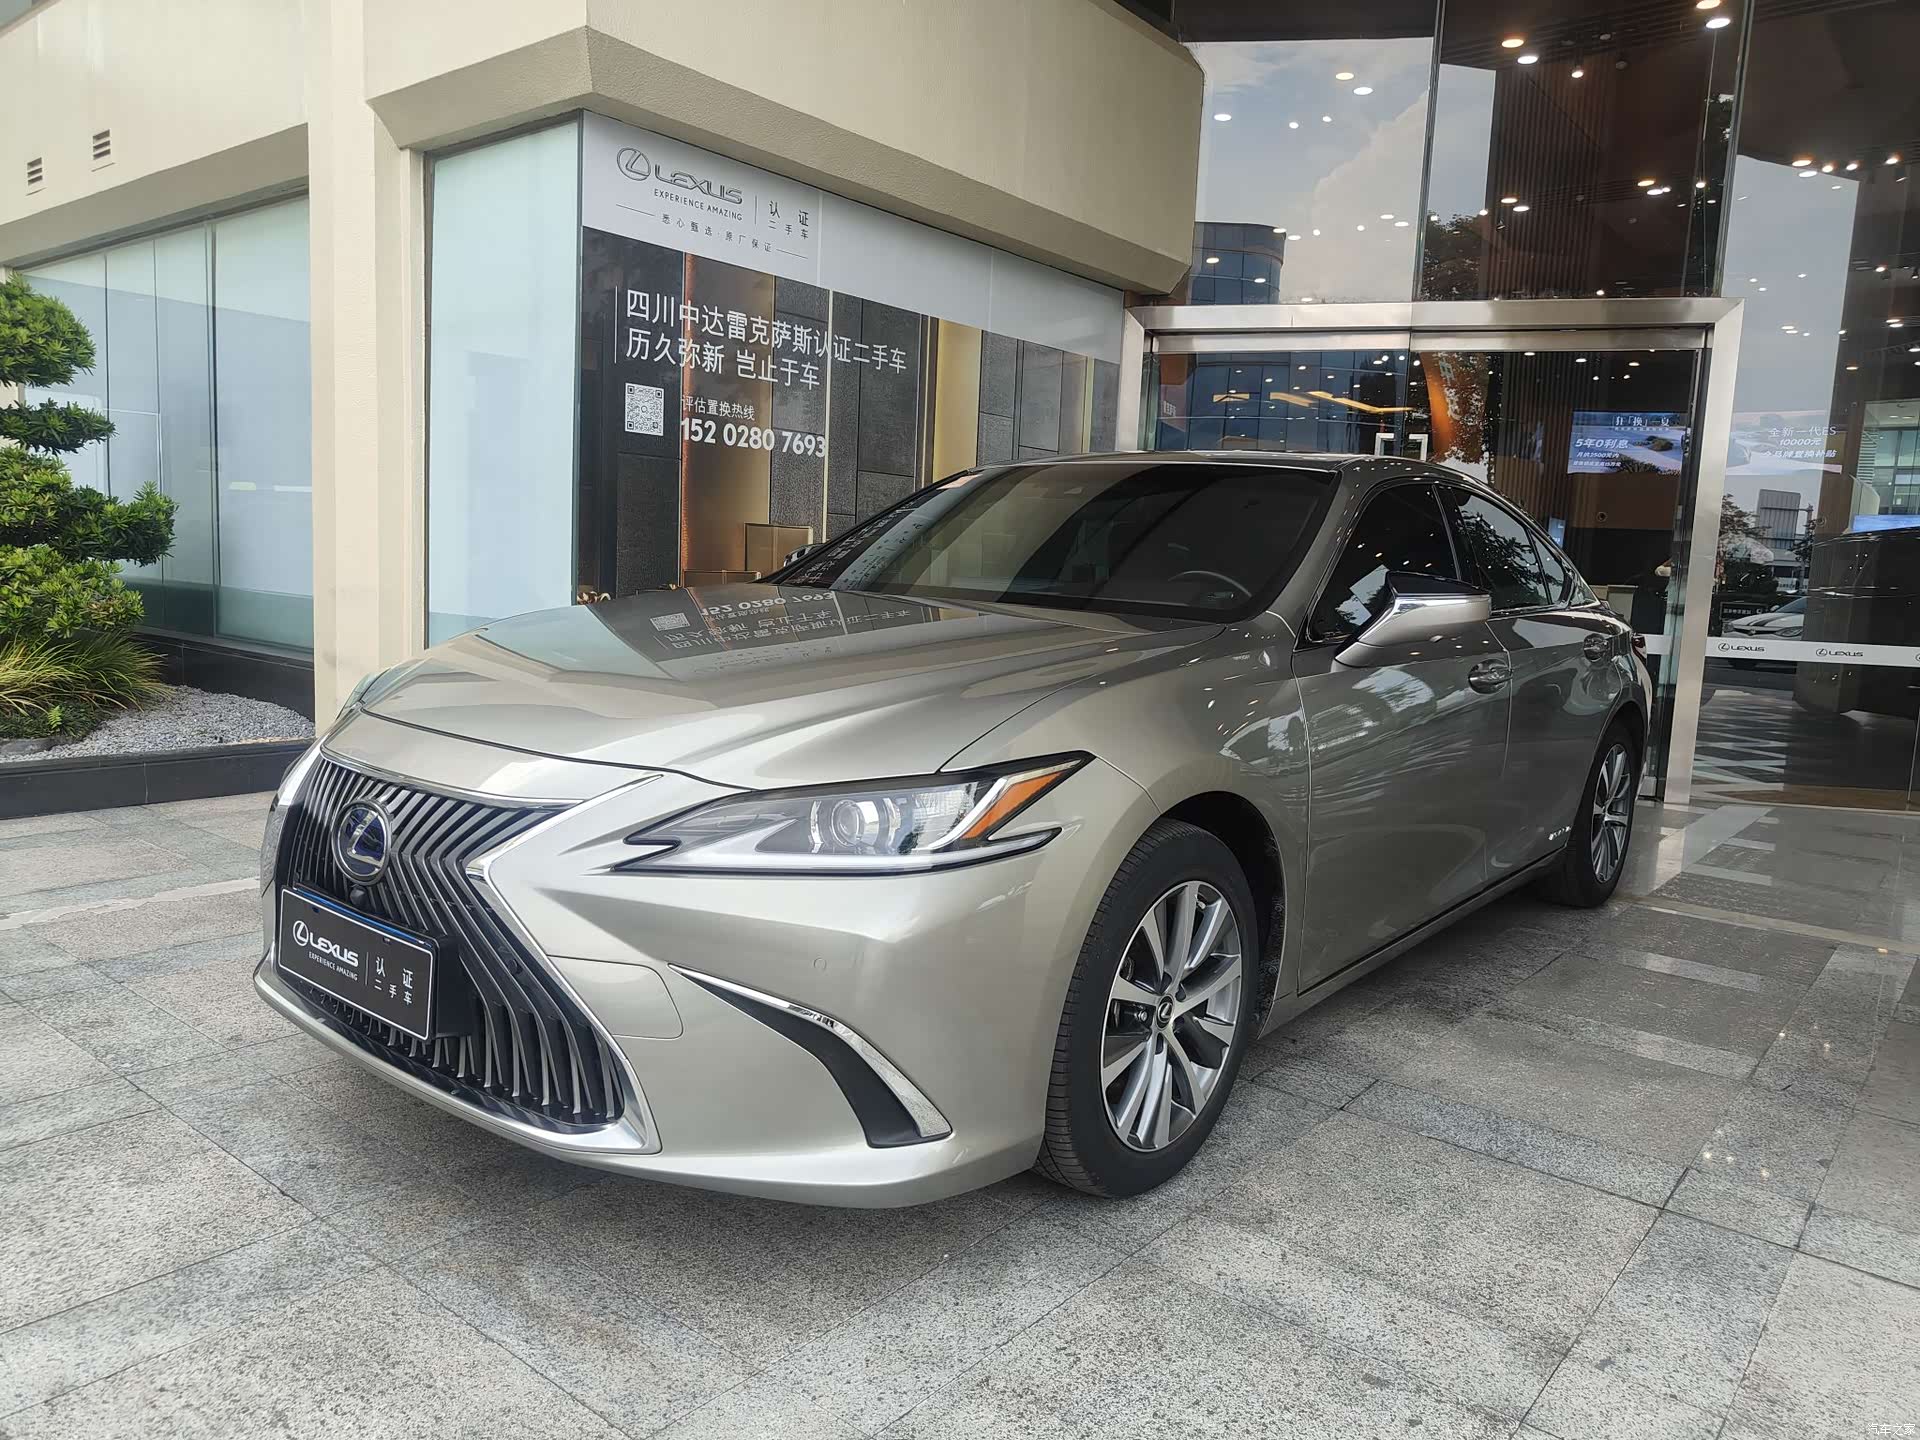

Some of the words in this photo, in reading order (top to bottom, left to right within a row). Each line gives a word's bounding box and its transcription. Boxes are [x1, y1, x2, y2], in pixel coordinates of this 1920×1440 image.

[655, 164, 743, 205] LEXUS
[654, 189, 704, 211] EXPERIENCE
[707, 205, 743, 221] AMAZING
[769, 200, 809, 227] 认证
[768, 220, 809, 240] 二手车
[626, 288, 907, 374] 四川中达雷克萨斯认证二手车
[626, 327, 725, 375] 历久弥新
[736, 350, 820, 390] 岂止于车
[682, 395, 756, 421] 评估置换热线
[681, 417, 717, 444] 152
[723, 423, 775, 451] 0280
[782, 431, 826, 458] 7693
[1575, 438, 1629, 449] 5年0利息
[1768, 426, 1837, 438] 全新一代ES
[1780, 437, 1822, 446] 10000元
[309, 931, 359, 968] LEXUS
[308, 952, 336, 971] EXPERIENCE
[336, 964, 358, 981] AMAZING
[375, 956, 414, 990] 认证
[374, 979, 413, 1006] 二手车
